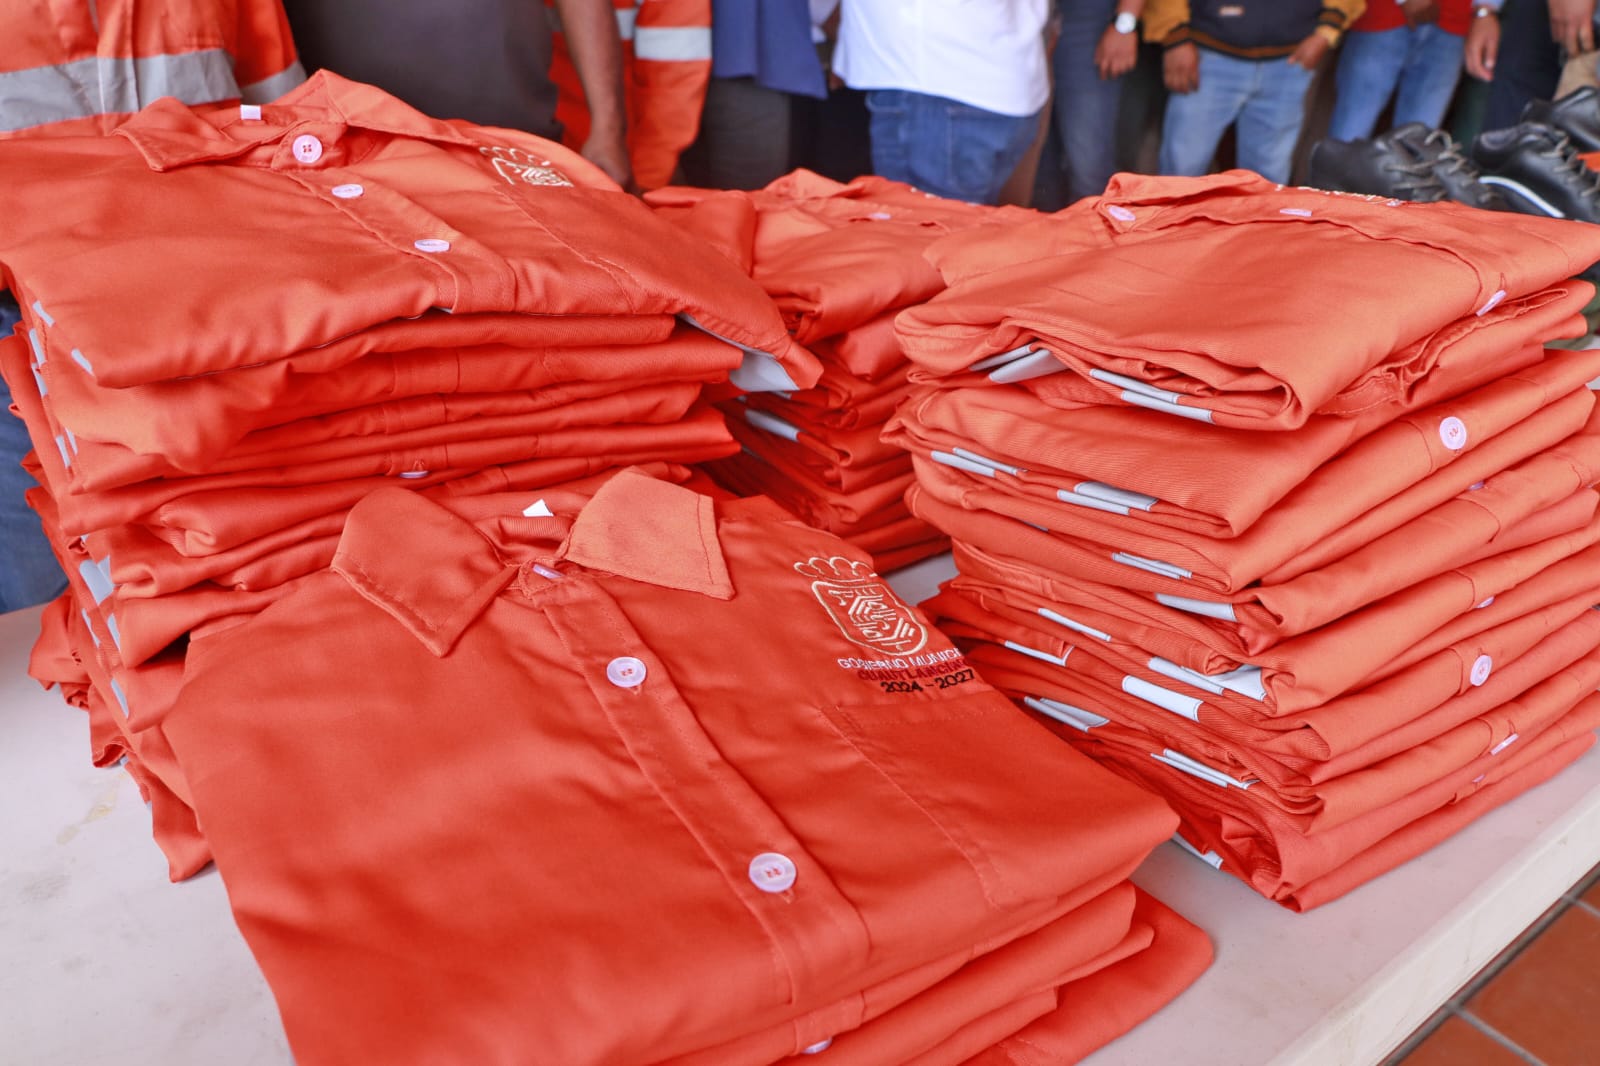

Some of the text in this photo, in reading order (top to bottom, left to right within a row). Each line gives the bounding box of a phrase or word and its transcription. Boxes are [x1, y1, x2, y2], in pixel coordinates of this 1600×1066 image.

[837, 657, 909, 670] GOBIERNO
[880, 680, 923, 693] 2024
[934, 668, 975, 690] 2027
